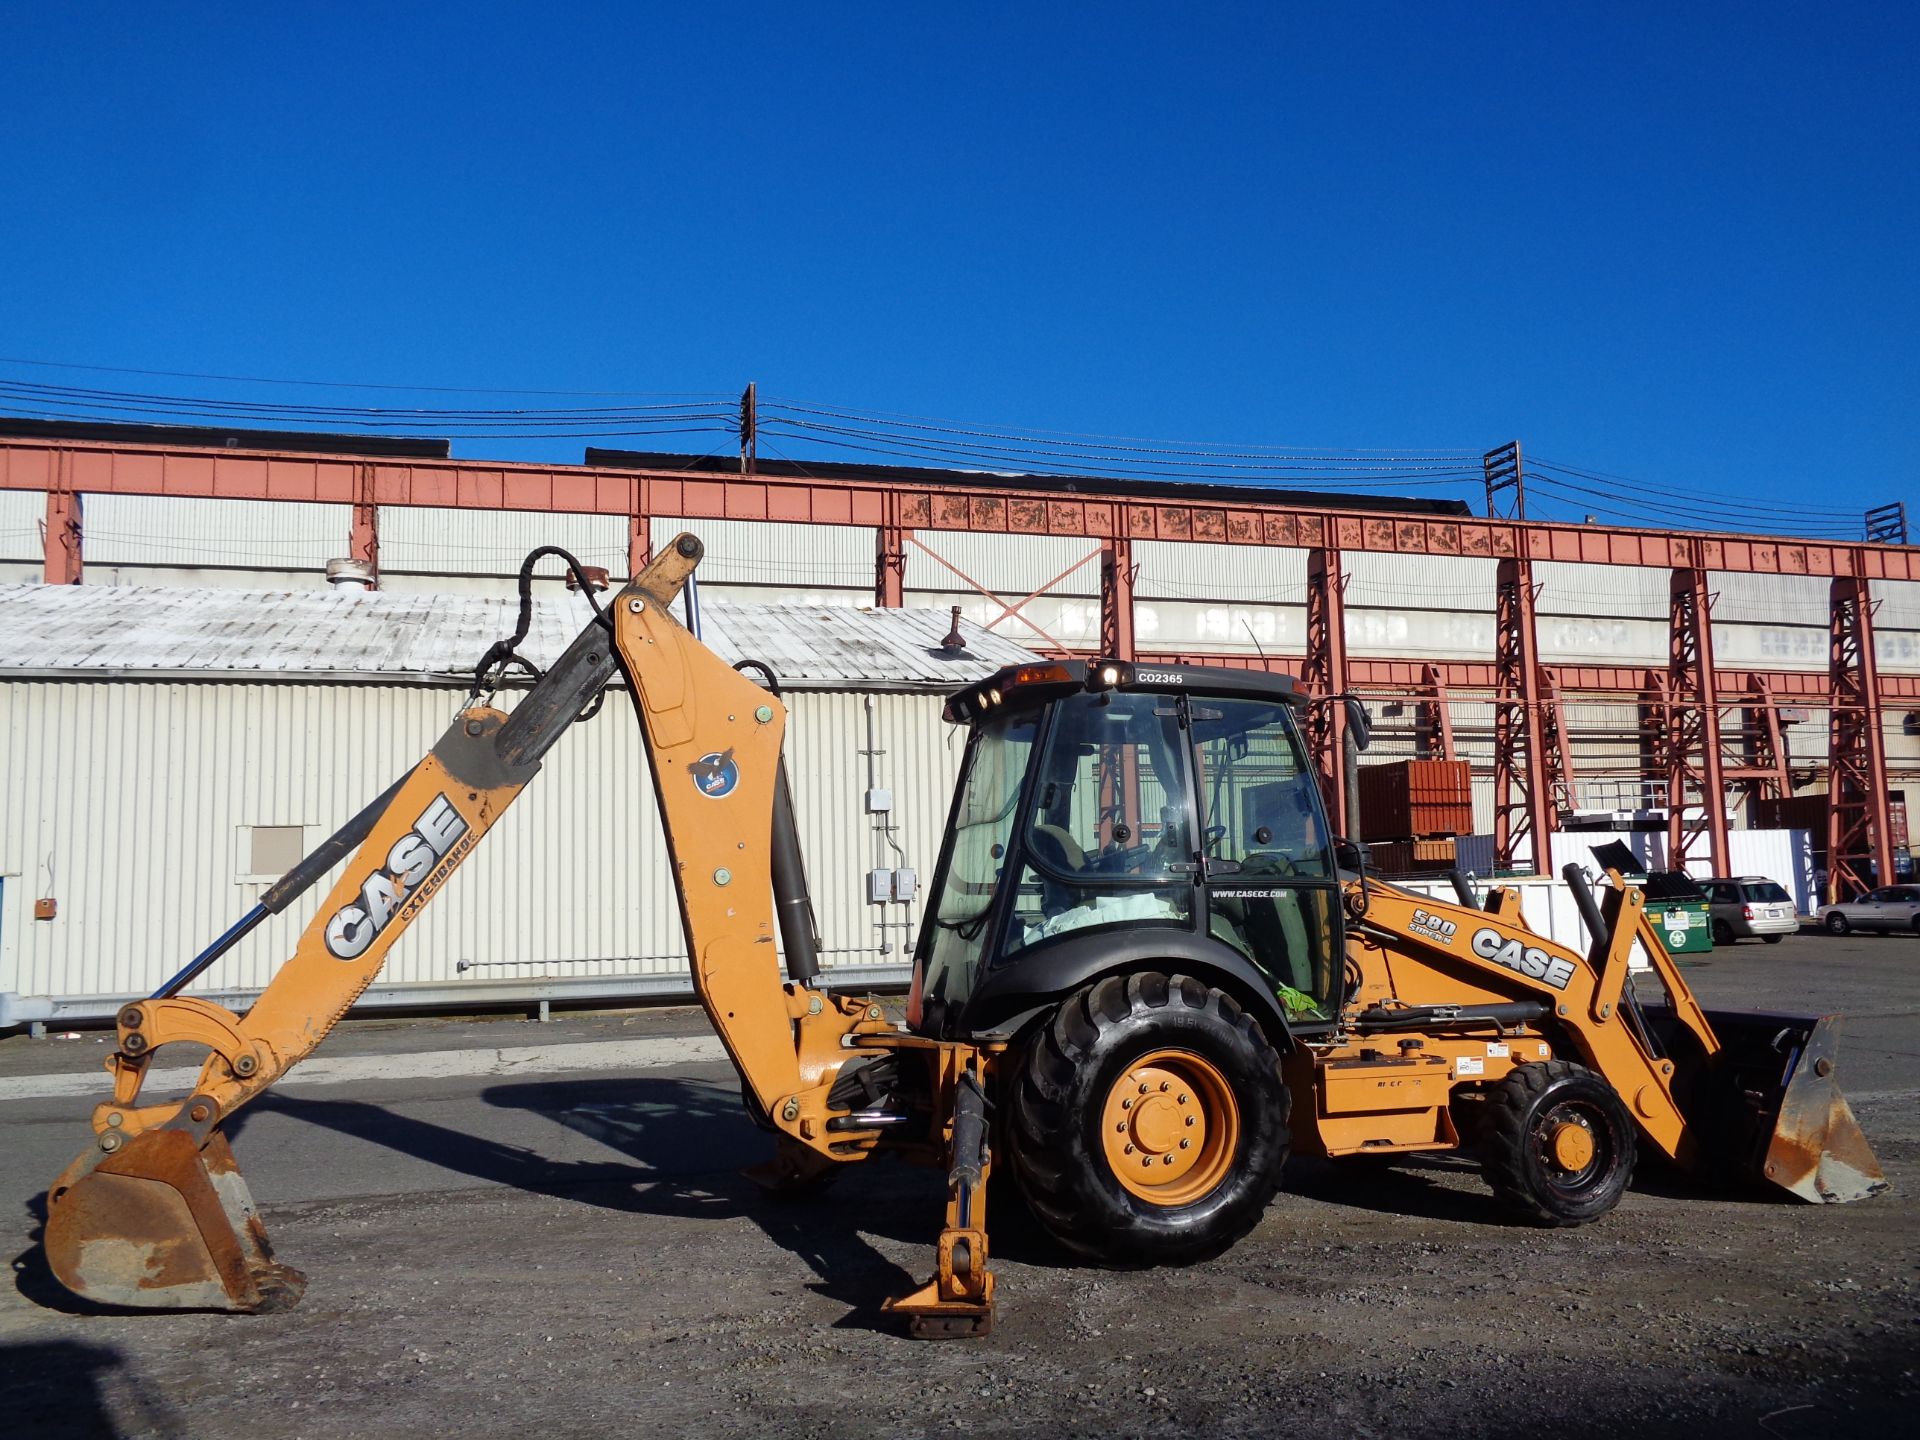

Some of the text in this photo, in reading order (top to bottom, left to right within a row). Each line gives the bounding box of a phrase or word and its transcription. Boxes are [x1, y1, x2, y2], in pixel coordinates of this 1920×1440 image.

[325, 792, 469, 959] CASE
[1212, 890, 1287, 898] WWW.CASECE.COM
[1407, 922, 1443, 942] SUPER
[1412, 909, 1456, 936] 580
[1472, 928, 1577, 991] CASE
